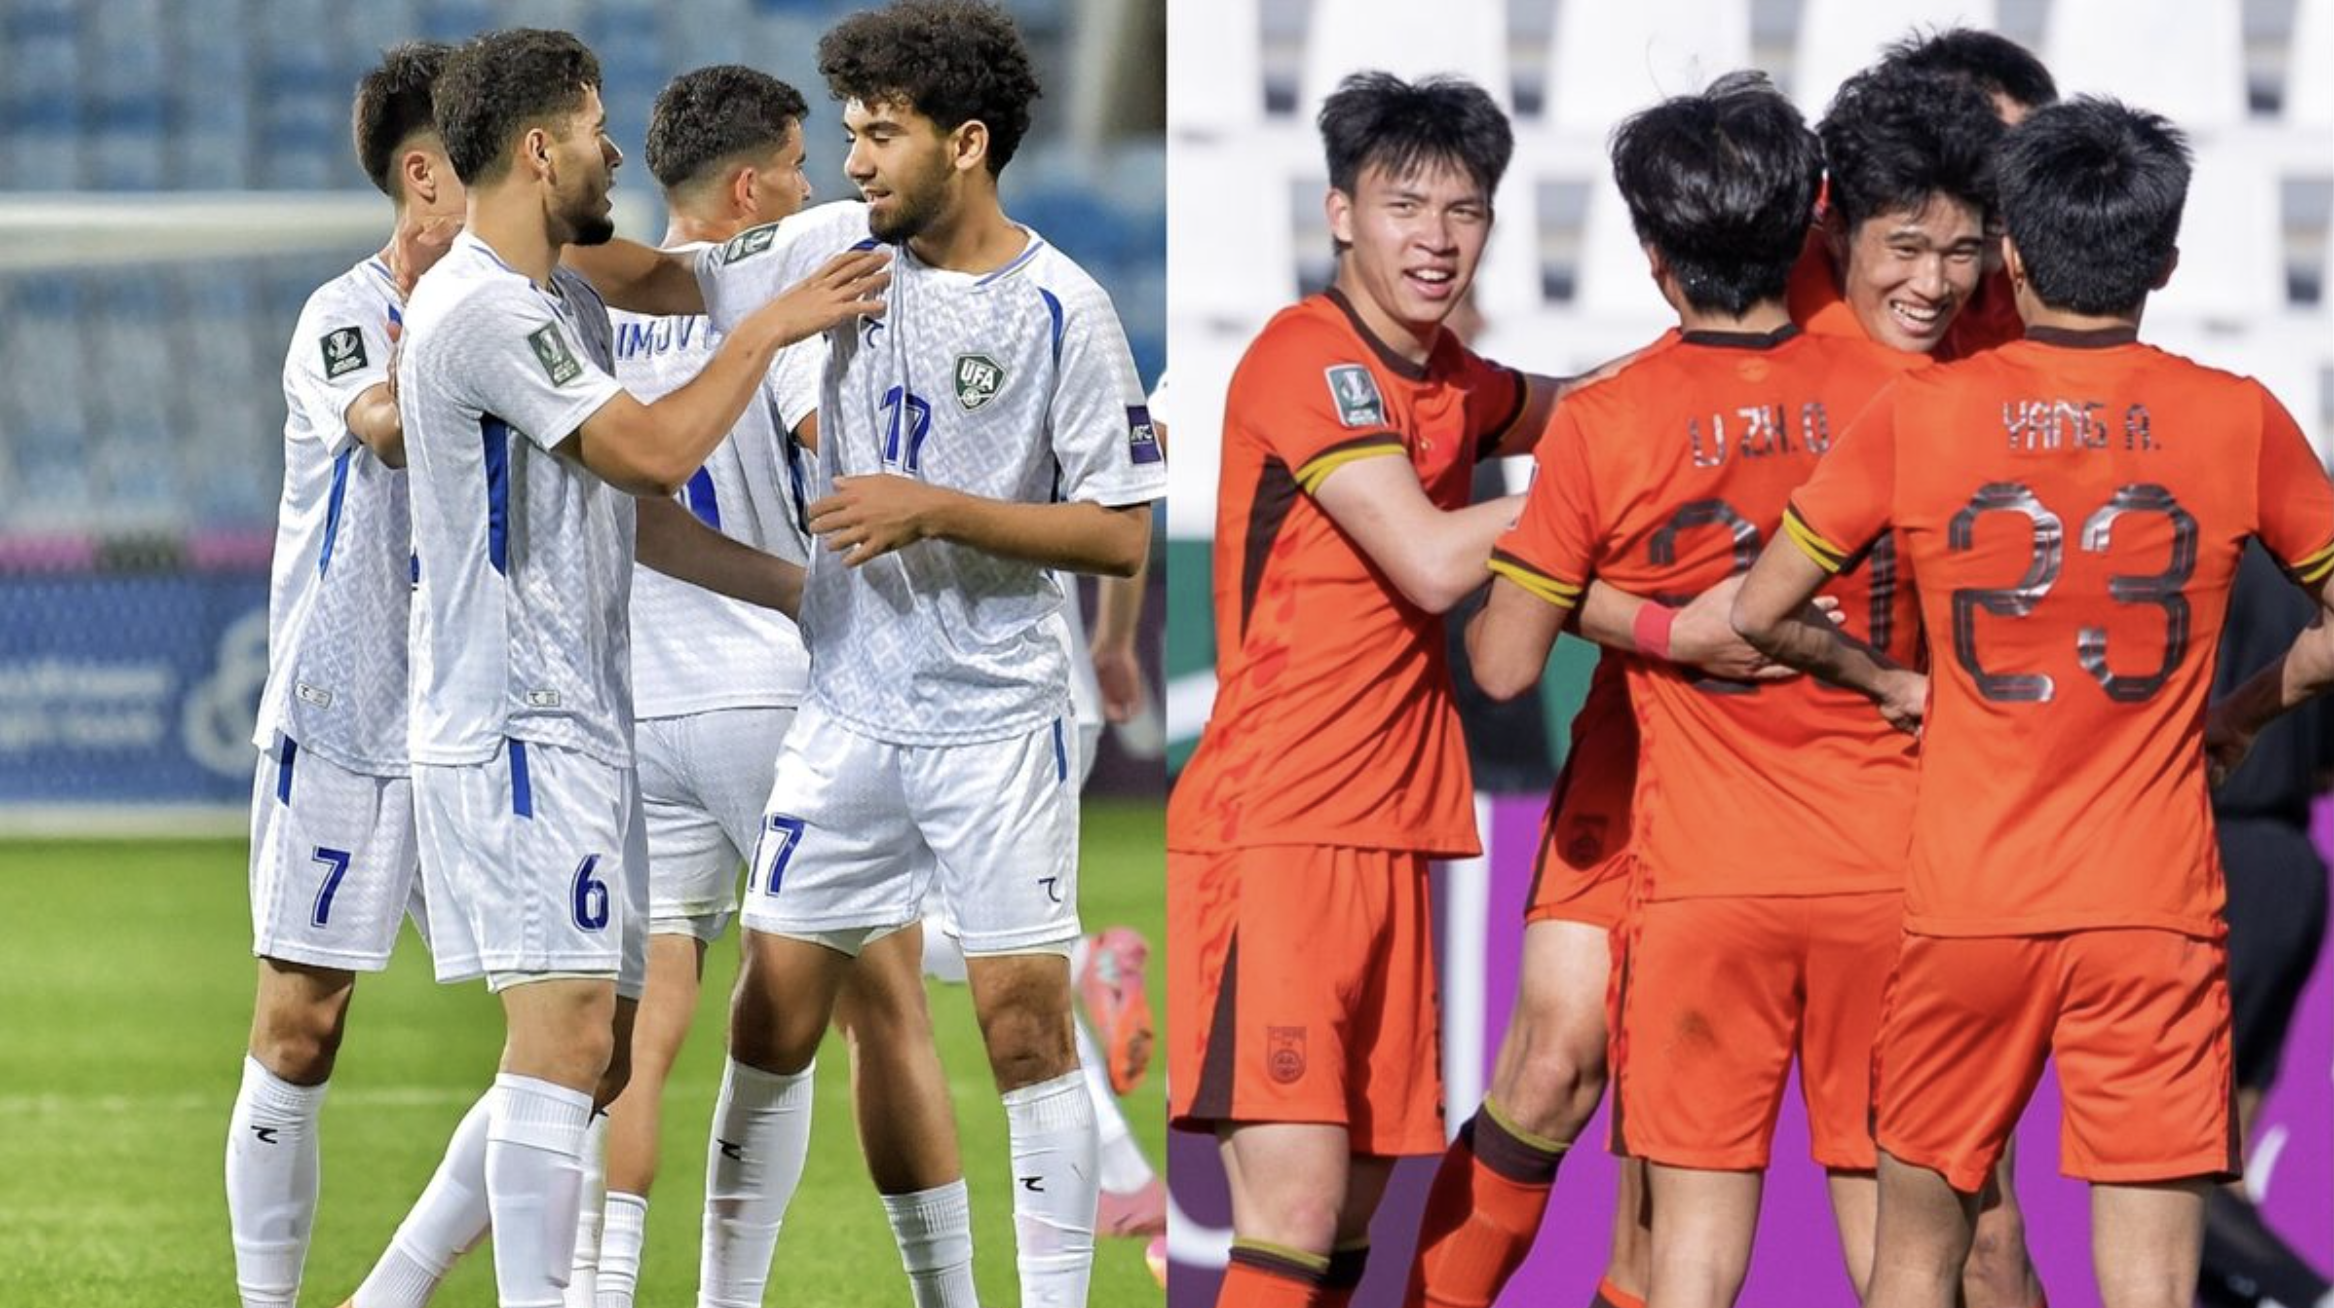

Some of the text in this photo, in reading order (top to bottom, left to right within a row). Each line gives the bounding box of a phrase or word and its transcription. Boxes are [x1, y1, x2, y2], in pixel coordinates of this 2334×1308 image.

[616, 314, 695, 360] IMOV
[961, 358, 997, 391] UFA
[880, 385, 931, 473] 17
[2003, 399, 2161, 451] YANG A.
[1948, 482, 2198, 703] 23
[311, 845, 351, 928] 7
[570, 853, 610, 933] 6
